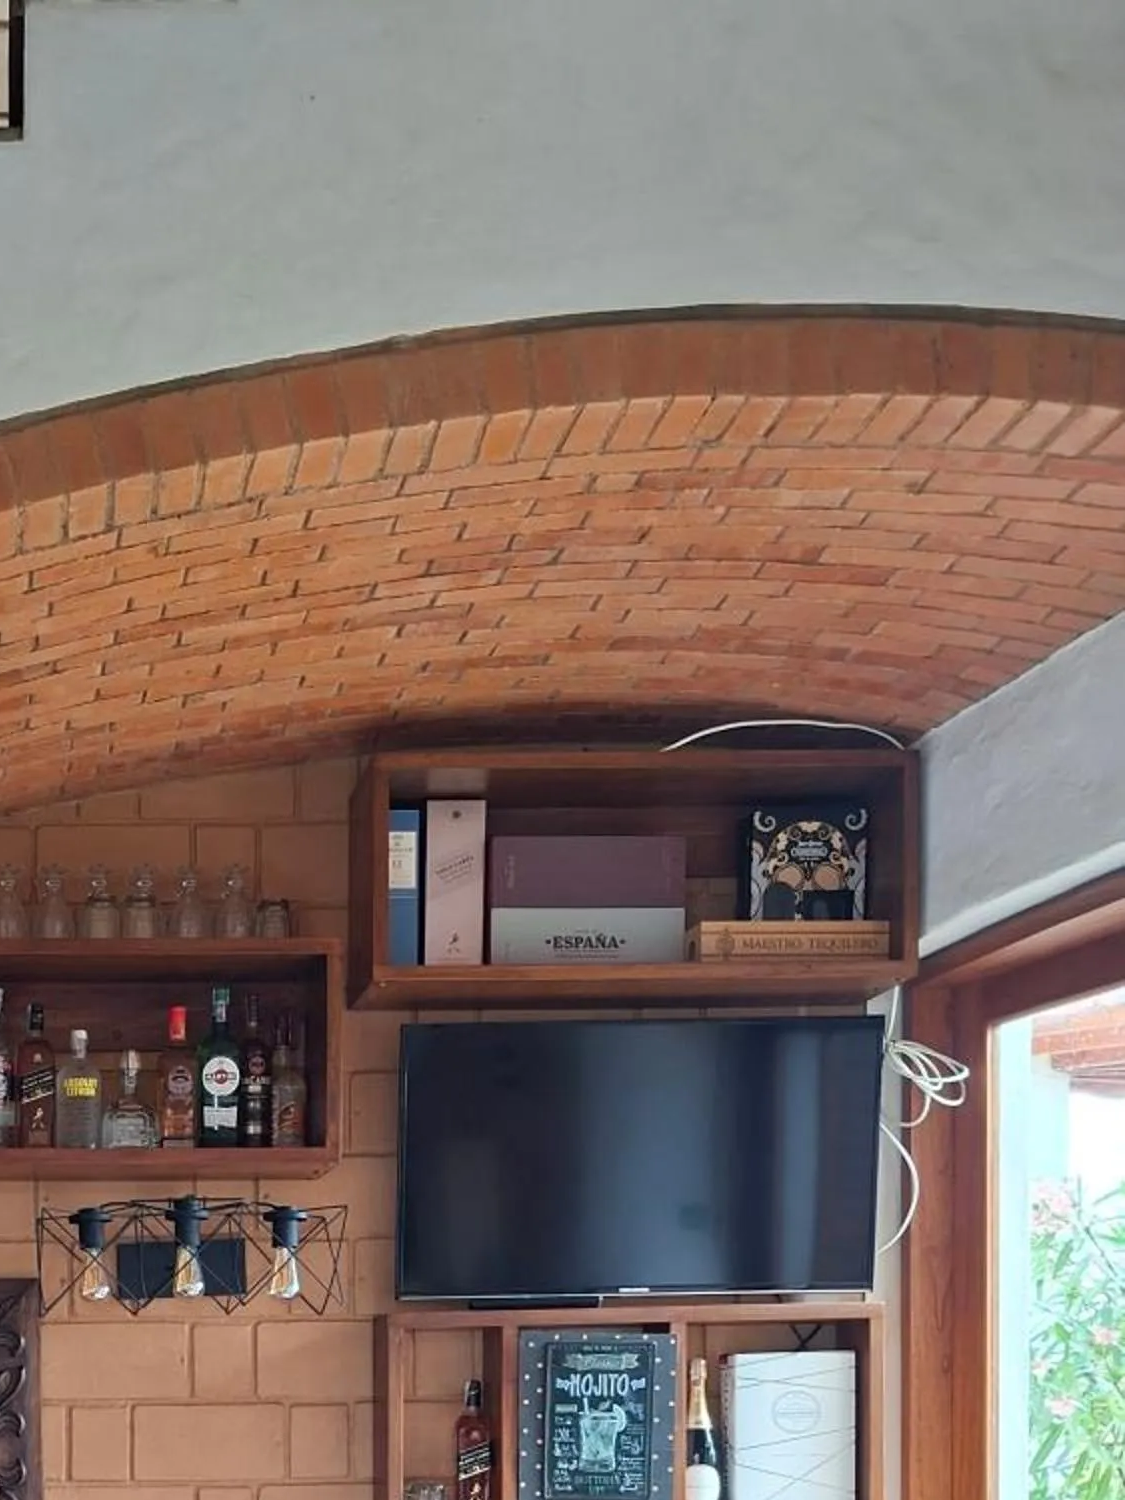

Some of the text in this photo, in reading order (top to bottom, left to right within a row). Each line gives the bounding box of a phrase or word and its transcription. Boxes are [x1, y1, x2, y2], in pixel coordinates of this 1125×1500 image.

[553, 932, 620, 949] ESPAÑA
[741, 937, 879, 952] MAESTRO TEQUILERO
[570, 1373, 629, 1397] MOJITO
